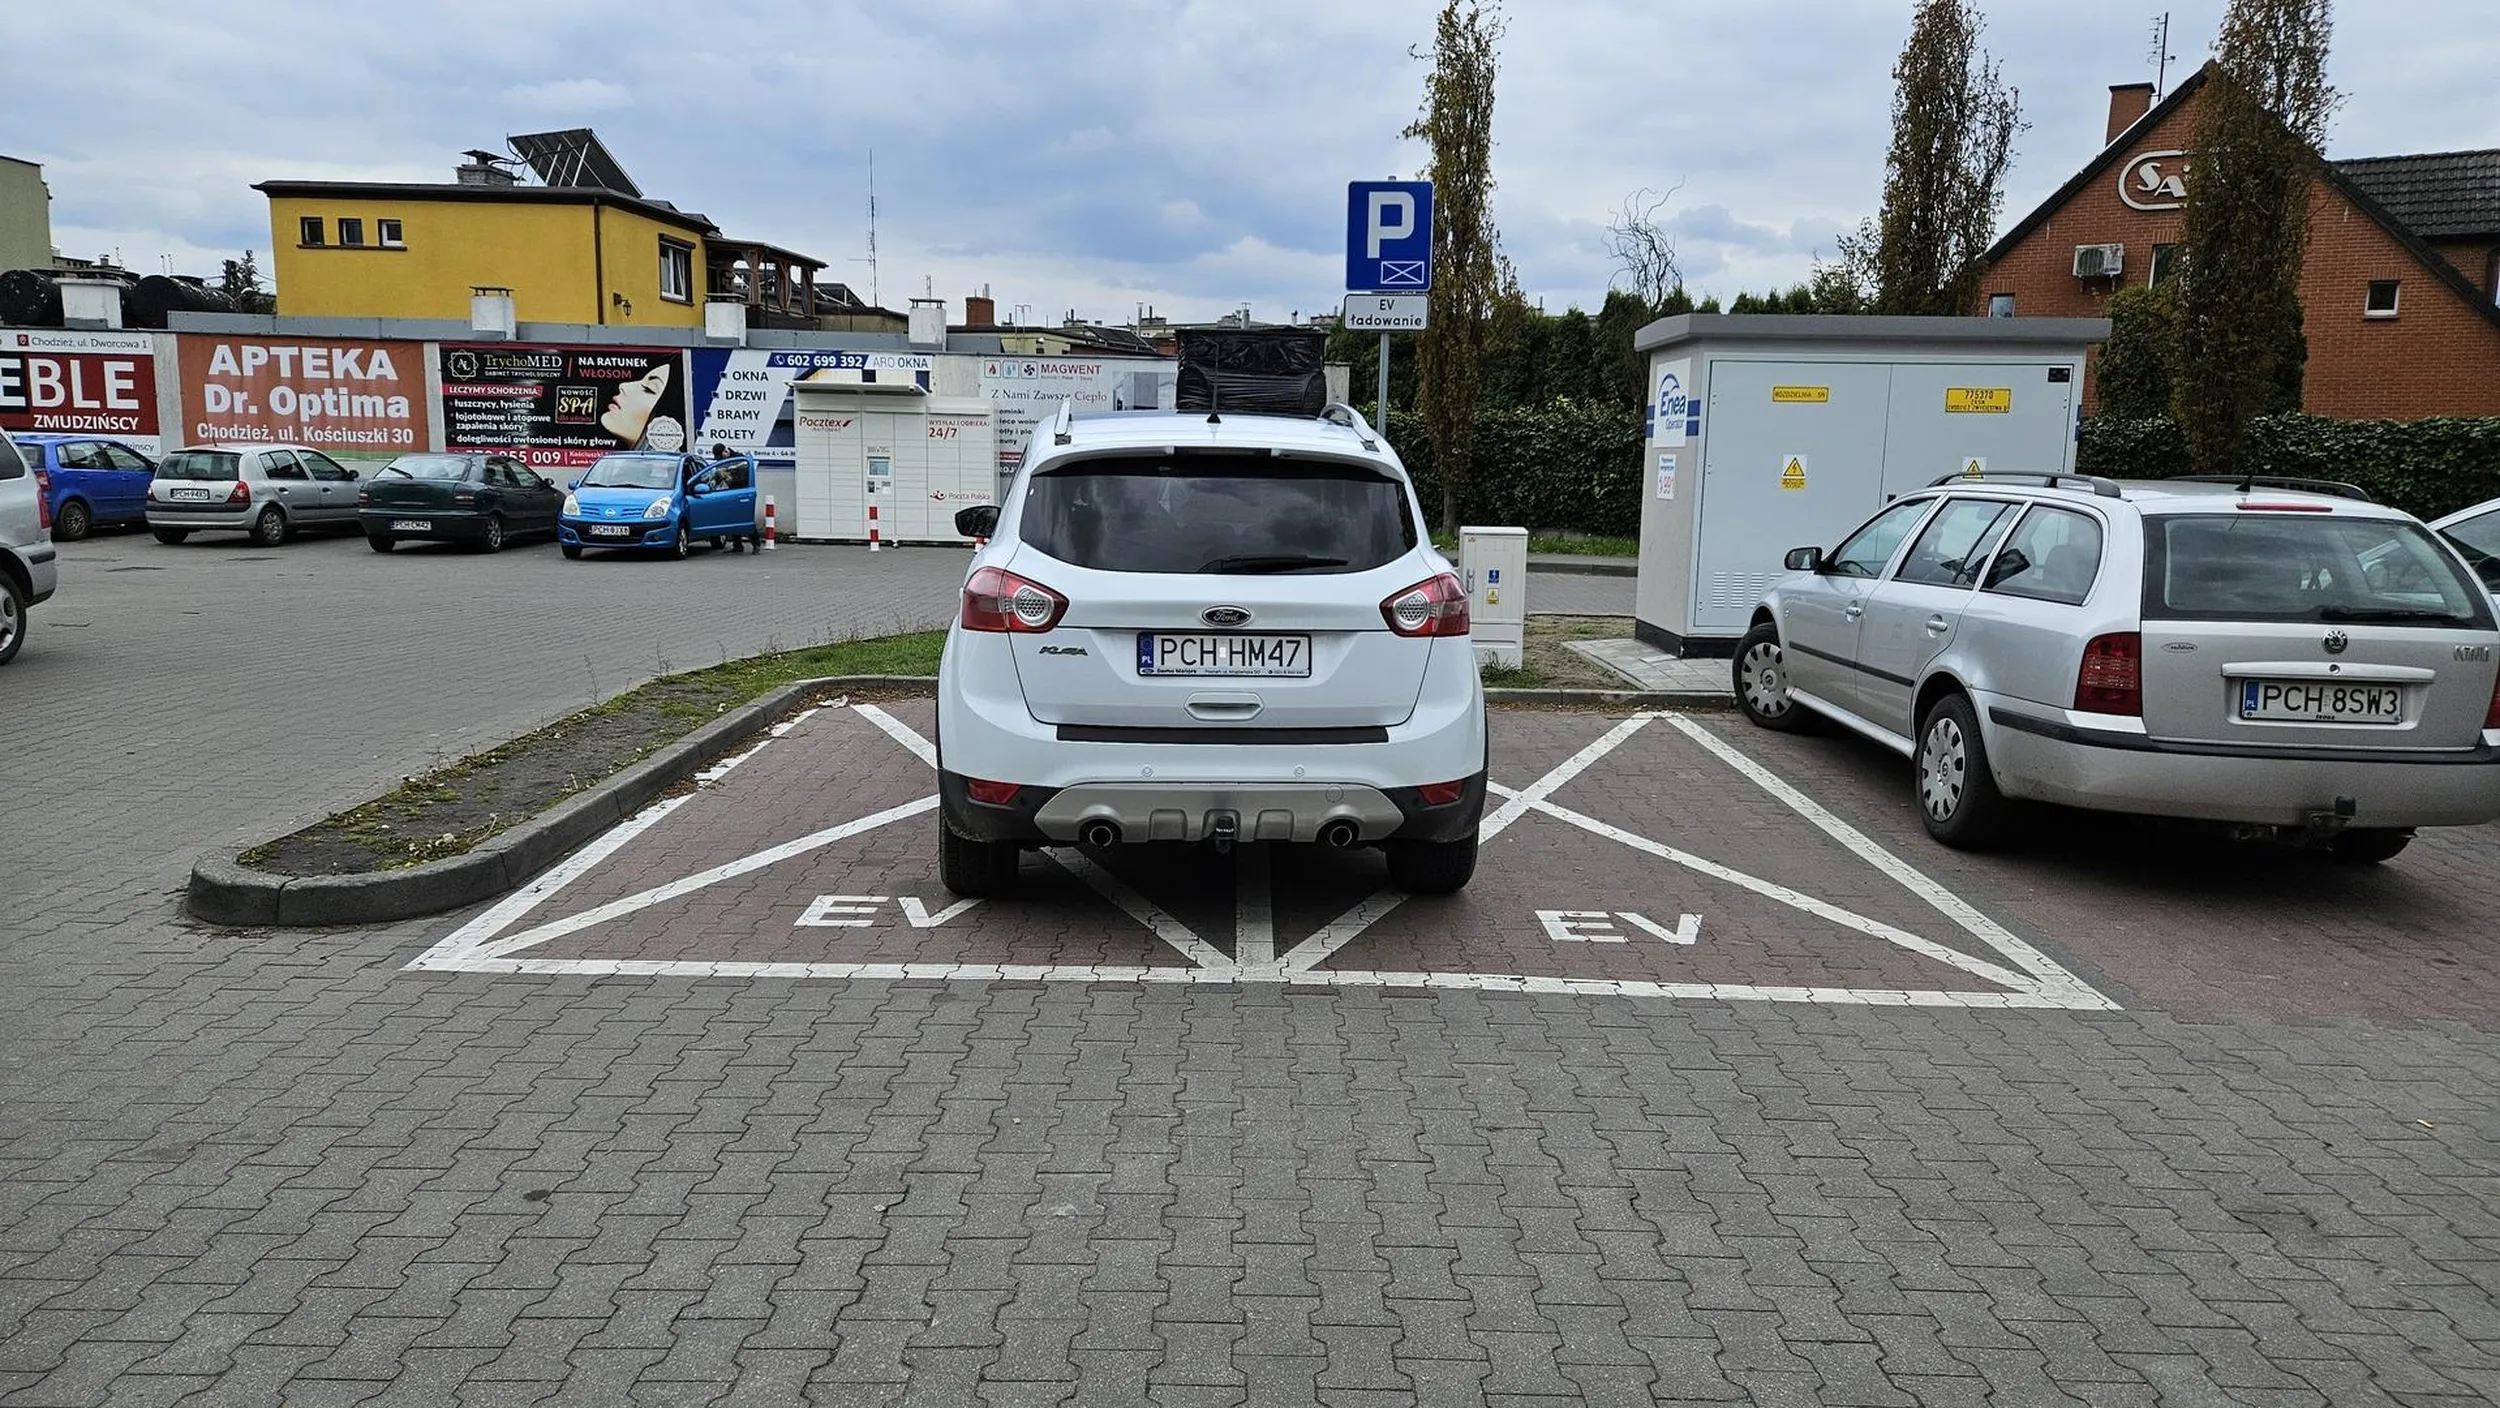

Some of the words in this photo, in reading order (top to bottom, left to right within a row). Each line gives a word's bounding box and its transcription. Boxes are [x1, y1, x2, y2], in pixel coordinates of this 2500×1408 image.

[2136, 162, 2188, 198] SA
[1366, 190, 1415, 259] P
[1379, 299, 1395, 311] EV
[1350, 314, 1422, 326] ładowanie
[31, 337, 76, 348] Chodzież,
[77, 338, 89, 348] ul.
[91, 339, 139, 349] Dworcowa
[142, 340, 147, 349] 1
[208, 343, 398, 381] APTEKA
[483, 353, 562, 369] TrychoMED
[578, 356, 596, 366] NA
[597, 357, 648, 368] RATUNEK
[786, 355, 810, 366] 602
[813, 355, 837, 367] 699
[840, 356, 863, 368] 392
[873, 356, 895, 367] ARO
[897, 357, 929, 368] OKNA
[579, 368, 632, 379] WŁOSOM
[1040, 364, 1102, 375] MAGWENT
[732, 370, 769, 382] OKNA
[449, 386, 485, 395] LECZYMY
[560, 388, 594, 396] NOWOŚĆ
[725, 390, 767, 401] DRZWI
[991, 389, 999, 399] Z
[1002, 389, 1030, 399] Nami
[1074, 391, 1108, 403] Ciepło
[204, 383, 258, 414] Dr.
[269, 384, 410, 422] Optima
[454, 398, 499, 409] łuszczycy,
[501, 399, 535, 409] łysienia
[558, 396, 594, 415] SPA
[1660, 391, 1686, 417] Enea
[33, 412, 139, 430] ZMUDZIŃSCY
[455, 412, 506, 422] łojotokowe
[512, 414, 551, 423] atopowe
[717, 410, 760, 421] BRAMY
[799, 416, 842, 427] Pocztex
[456, 421, 498, 431] zapalenia
[499, 421, 523, 432] skóry
[197, 422, 275, 443] Chodzież,
[278, 427, 299, 441] ul.
[304, 425, 388, 444] Kościuszki
[392, 427, 414, 444] 30
[710, 429, 756, 440] ROLETY
[928, 427, 957, 440] 24/7
[456, 434, 512, 445] dolegliwości
[513, 435, 562, 446] owłosionej
[563, 436, 587, 447] skóry
[589, 437, 617, 448] głowy
[532, 451, 561, 464] 009
[1213, 611, 1239, 622] Ford
[1160, 638, 1217, 666] PCH
[1229, 638, 1301, 667] HM47
[1141, 655, 1152, 664] PL
[2245, 699, 2257, 708] PL
[2262, 684, 2323, 713] PCH
[2332, 687, 2398, 715] 8SW3
[793, 894, 985, 928] EV
[1534, 909, 1704, 945] EV
